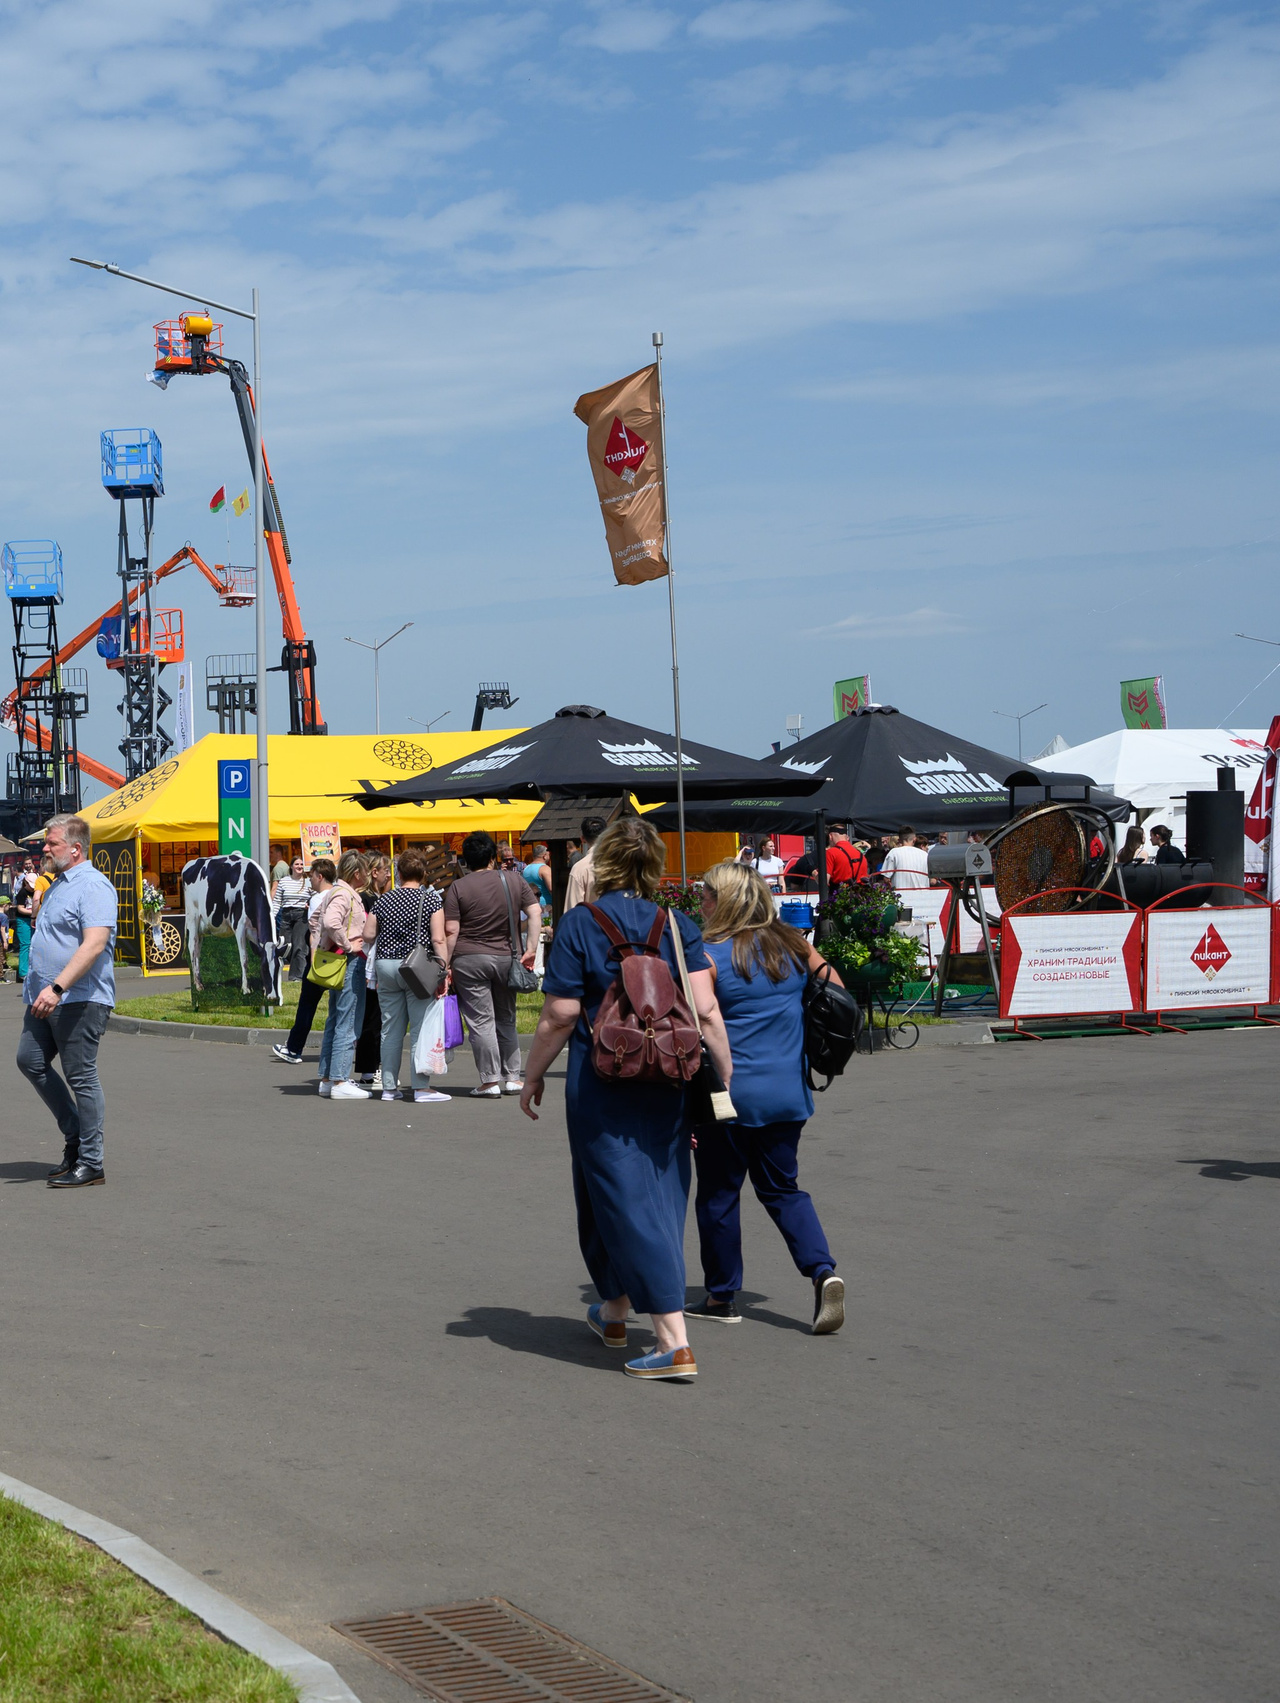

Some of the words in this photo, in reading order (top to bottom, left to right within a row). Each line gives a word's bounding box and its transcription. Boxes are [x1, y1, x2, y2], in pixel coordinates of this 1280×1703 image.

[230, 770, 243, 788] P
[905, 773, 1010, 795] GORILLA
[228, 817, 245, 839] N
[308, 825, 331, 837] КВАС
[1027, 959, 1065, 967] ХРАНИМ
[1067, 956, 1116, 966] ТРАДИЦИИ
[1033, 972, 1078, 982] СОЗДАЕМ
[1079, 971, 1110, 979] НОВЫЕ
